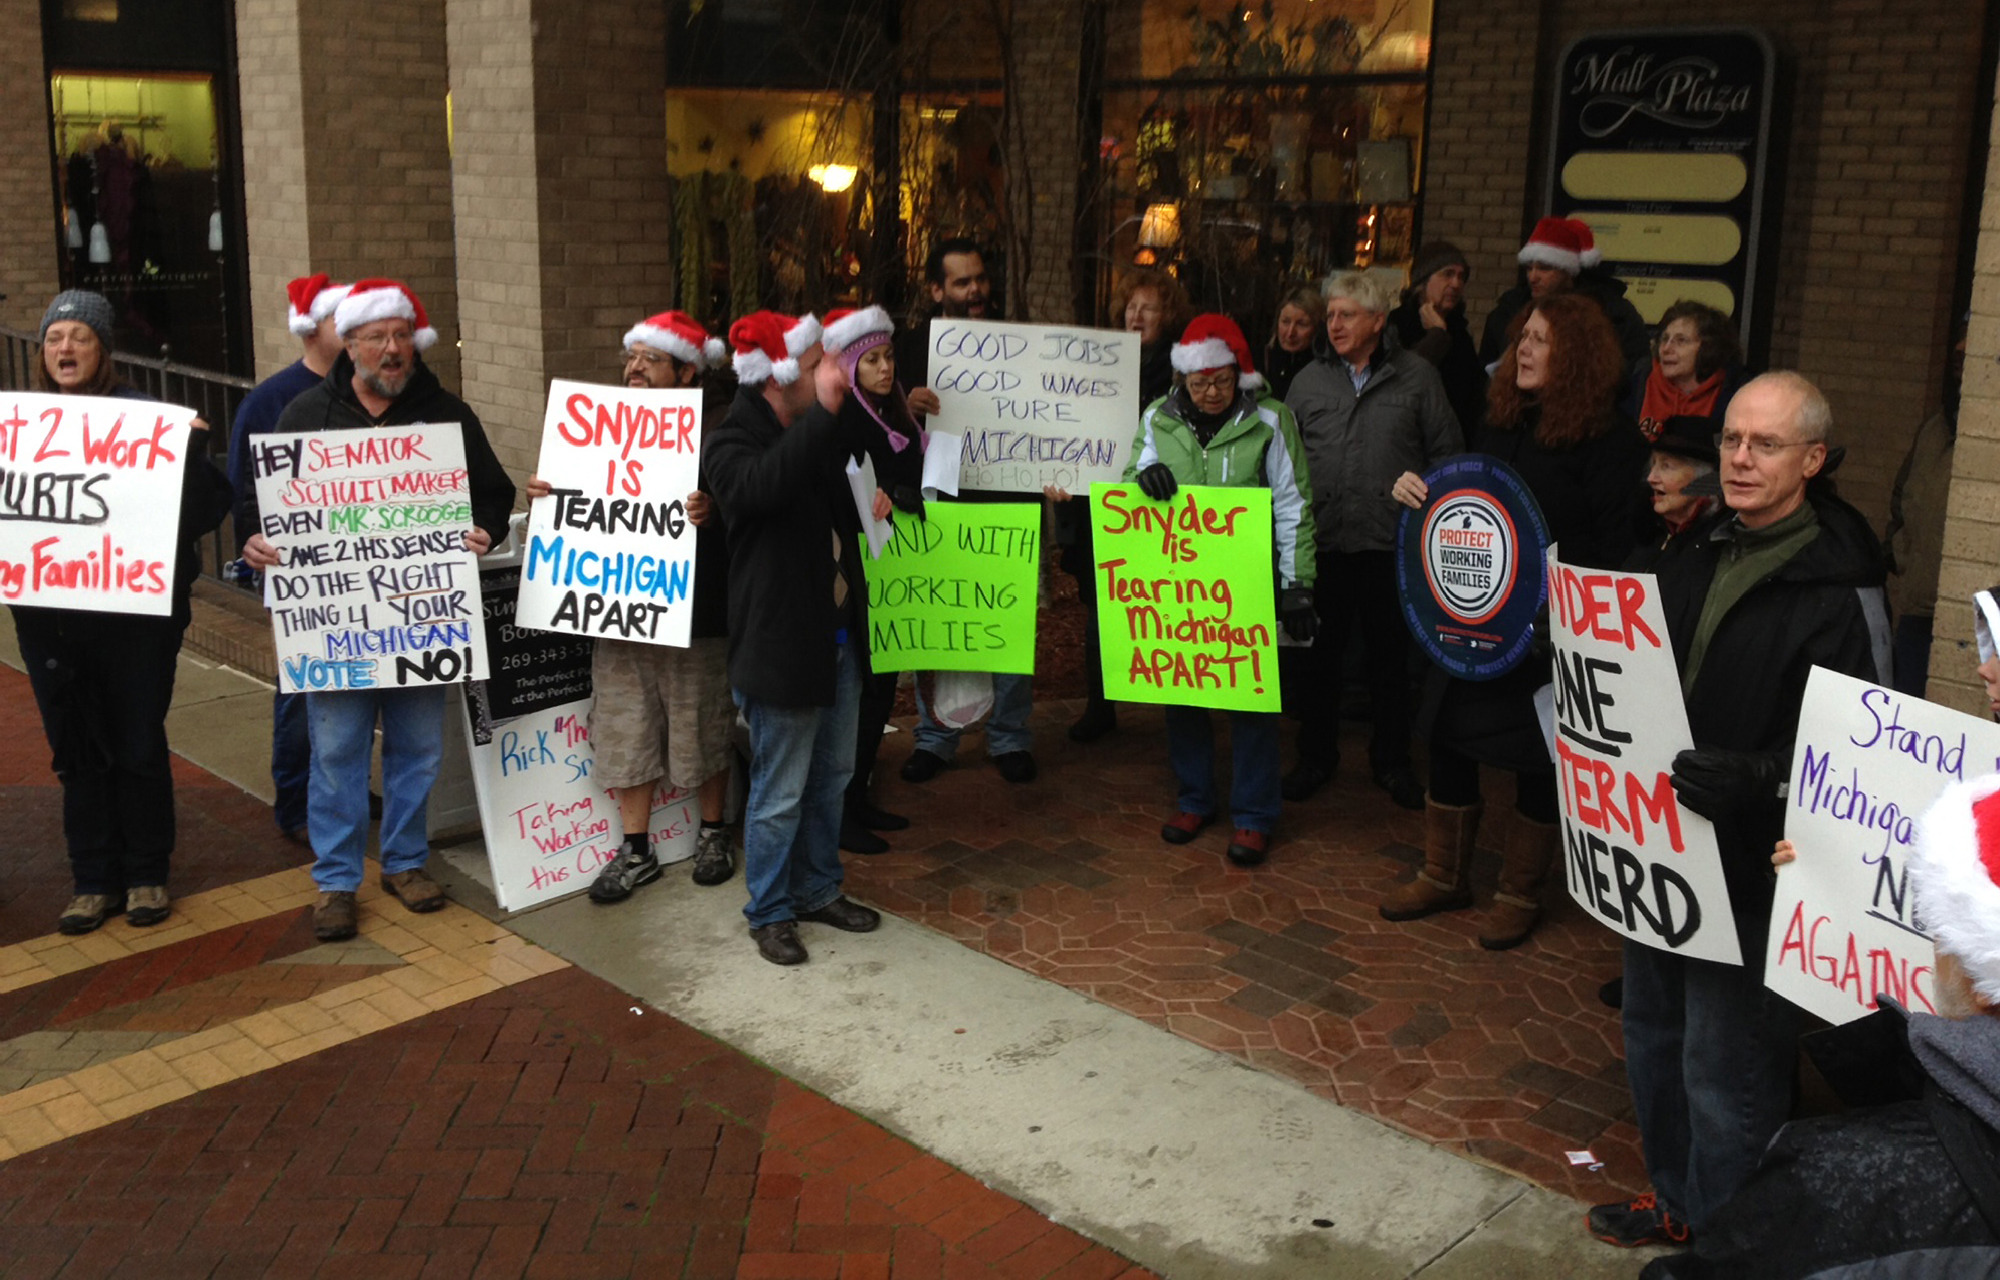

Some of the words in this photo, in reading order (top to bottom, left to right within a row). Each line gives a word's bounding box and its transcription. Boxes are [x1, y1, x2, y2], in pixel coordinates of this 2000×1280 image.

[1571, 46, 1654, 96] Mall
[1653, 56, 1752, 114] Plaza
[936, 327, 1028, 362] GOOD
[1039, 333, 1123, 366] JOBS
[935, 364, 1021, 394] GOOD
[1041, 371, 1121, 398] WAGES
[557, 393, 695, 460] SNYDER
[991, 396, 1080, 422] PURE
[33, 407, 70, 463] 2
[82, 412, 176, 470] Work
[252, 438, 303, 479] HEY
[307, 433, 432, 473] SENATOR
[961, 427, 1117, 467] MICHIGAN
[0, 467, 111, 526] URTS
[606, 459, 644, 496] IS
[263, 509, 323, 538] EVEN
[378, 502, 471, 530] SCROOGE
[548, 488, 686, 540] TEARING
[1102, 490, 1248, 555] Snyder
[275, 541, 333, 570] CAME
[335, 539, 353, 562] 2
[353, 535, 390, 562] HIS
[391, 530, 470, 558] SENSES
[958, 523, 1036, 564] WITH
[1170, 533, 1198, 564] is
[1439, 528, 1494, 548] PROTECT
[1440, 549, 1493, 569] WORKING
[31, 532, 166, 594] Families
[272, 574, 309, 601] DO
[310, 571, 364, 597] THE
[367, 562, 467, 602] RIGHT
[527, 535, 690, 604] MICHIGAN
[1441, 569, 1492, 590] FAMILIES
[275, 604, 340, 637] THING
[349, 604, 369, 629] 4
[387, 590, 472, 625] YOUR
[1098, 558, 1233, 624] Tearing
[550, 590, 668, 639] APART
[1126, 604, 1270, 664] Michigan
[325, 622, 470, 659] MICHIGAN
[283, 654, 377, 690] VOTE
[396, 647, 472, 686] NO!
[1128, 646, 1265, 695] APART!
[1552, 642, 1632, 744] ONE
[501, 730, 556, 777] Rick
[1850, 688, 1966, 782] Stand
[1554, 735, 1685, 853] TERM
[509, 797, 593, 840] Taking
[532, 818, 610, 854] Working
[527, 866, 570, 890] this
[1567, 816, 1701, 949] NERD
[1872, 855, 1927, 932] N
